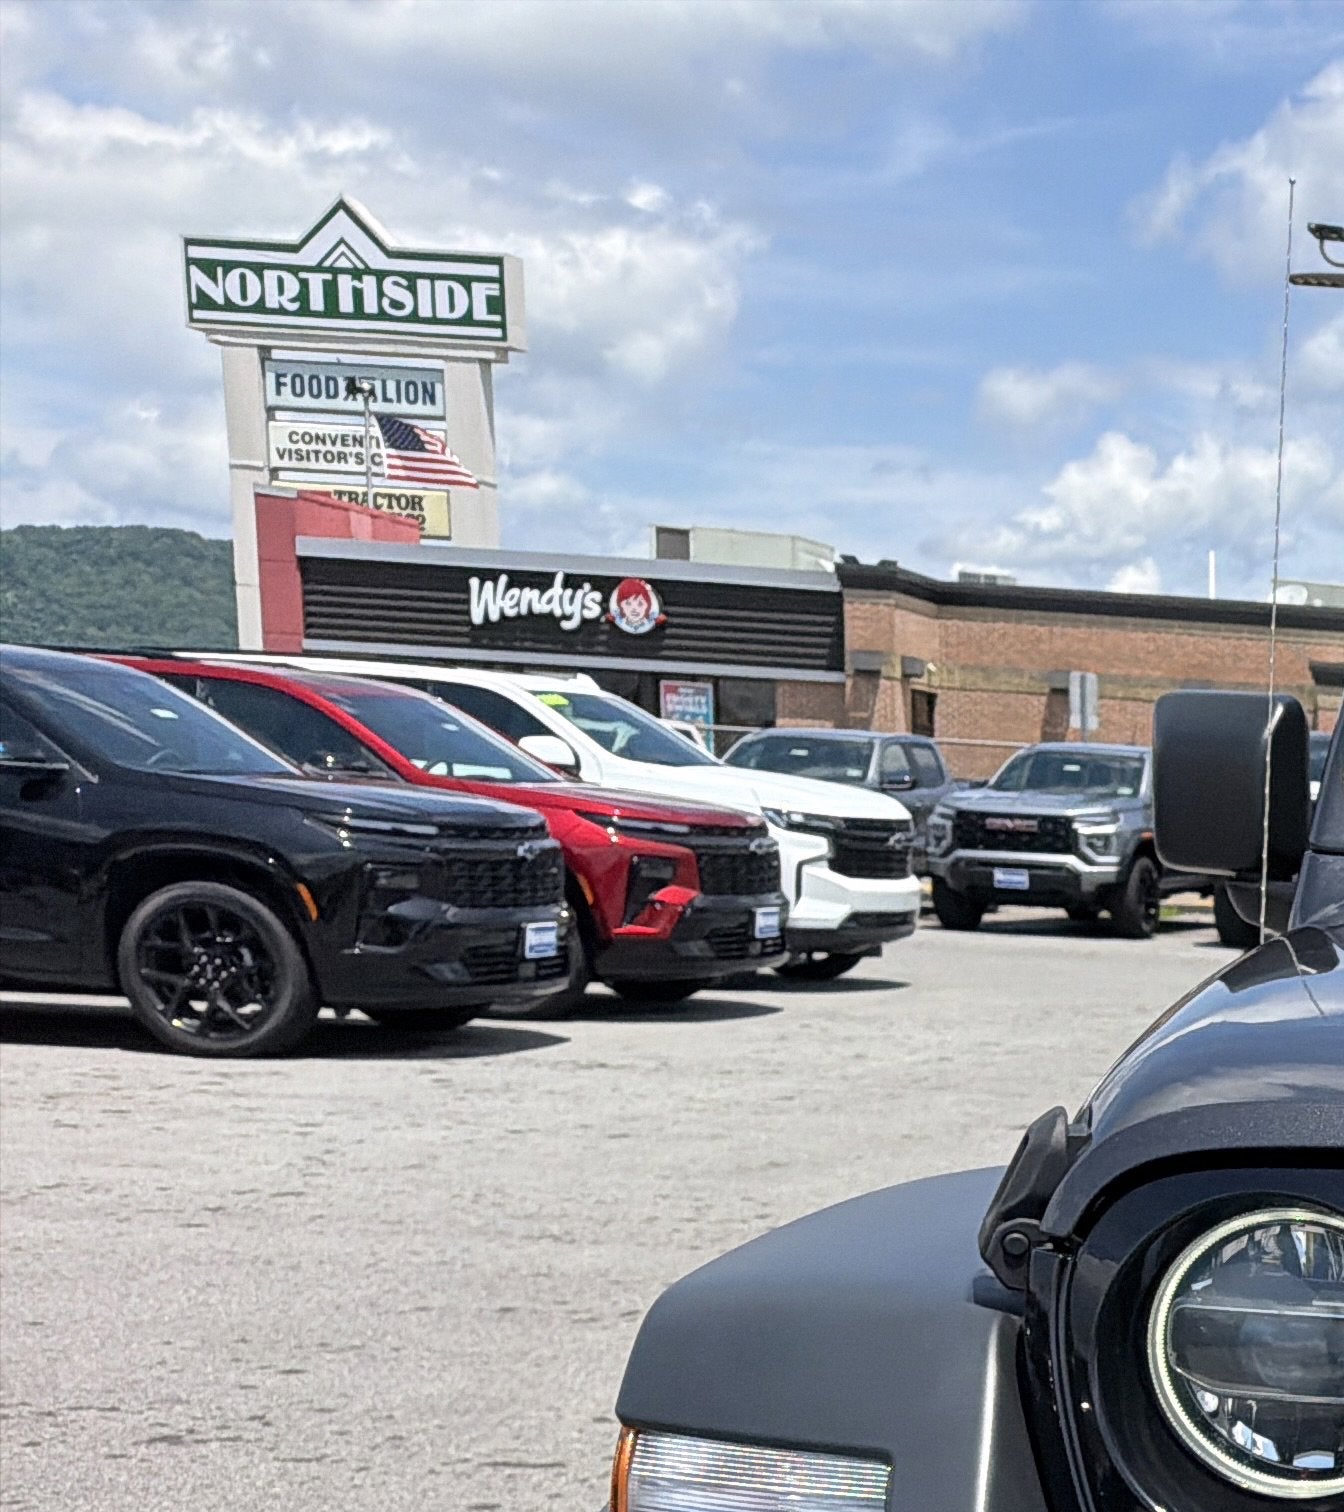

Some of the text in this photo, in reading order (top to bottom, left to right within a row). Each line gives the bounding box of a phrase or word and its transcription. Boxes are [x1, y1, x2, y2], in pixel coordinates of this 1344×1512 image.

[189, 264, 502, 321] NORTHSIDE
[274, 372, 437, 406] FOOD LION
[275, 446, 366, 466] VISITOR'S
[468, 570, 603, 631] Wendy's
